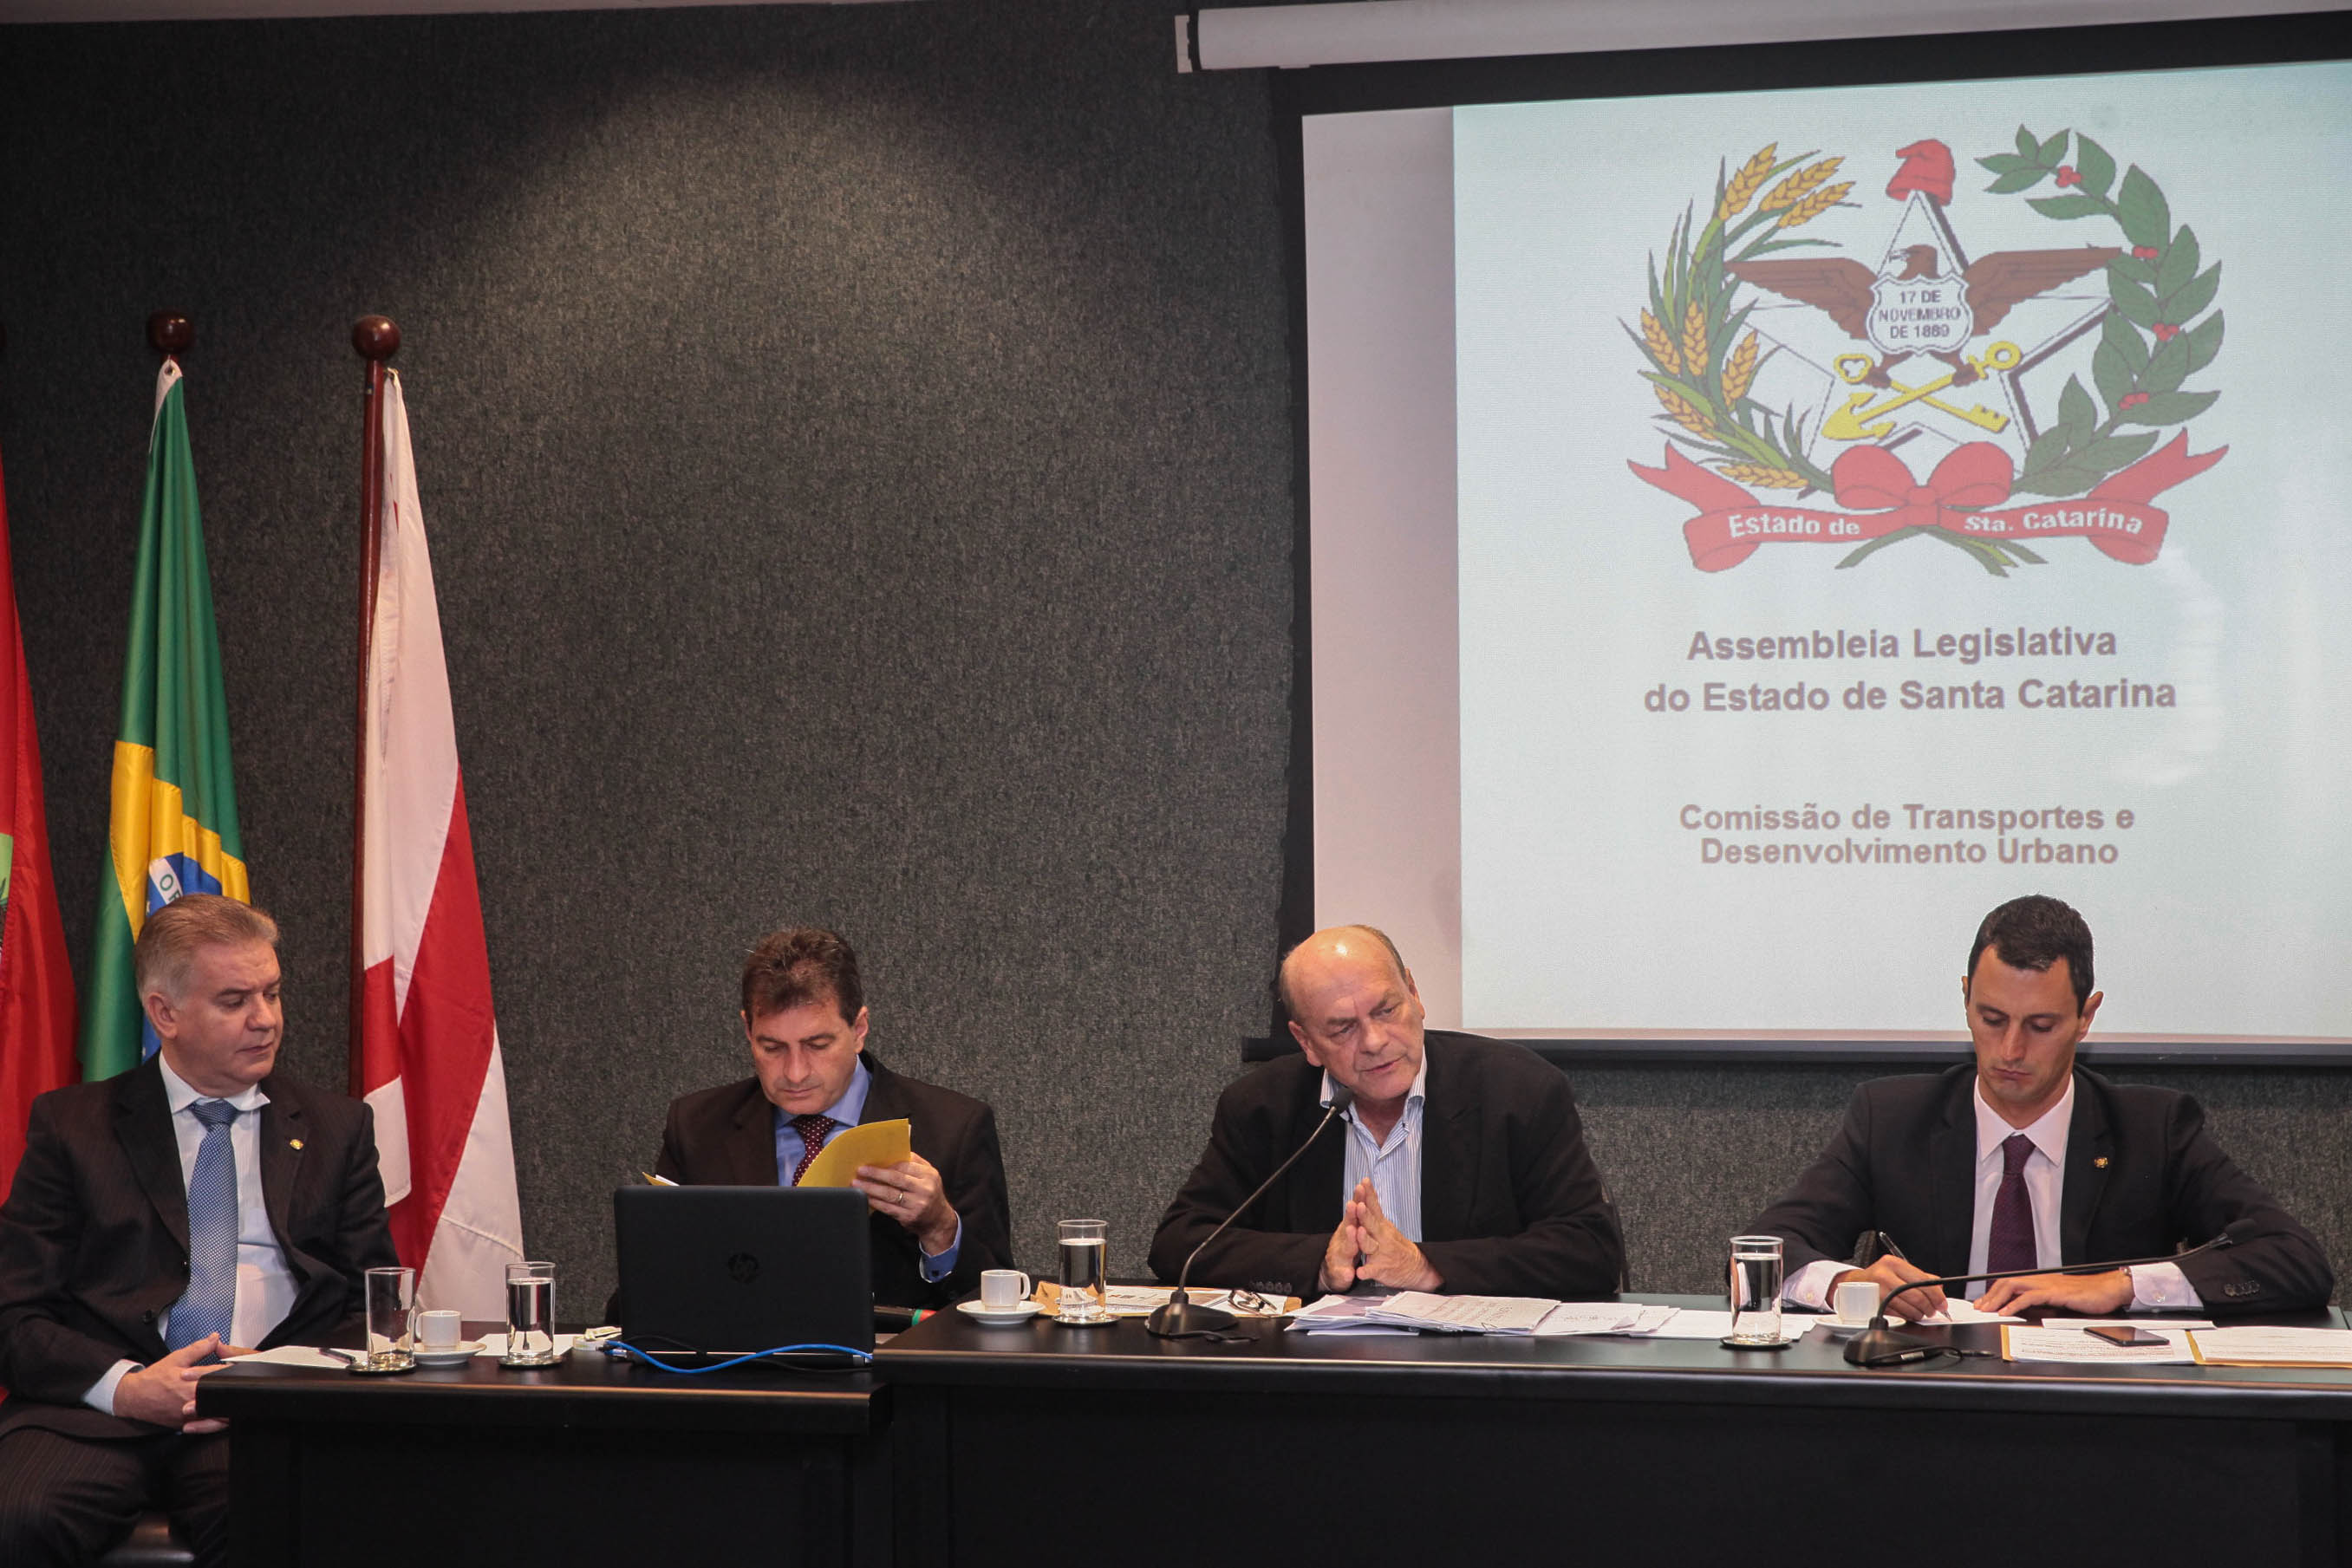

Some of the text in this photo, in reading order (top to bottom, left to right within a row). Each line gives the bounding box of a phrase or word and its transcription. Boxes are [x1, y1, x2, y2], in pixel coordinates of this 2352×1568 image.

[1900, 290, 1942, 304] 17 DE
[1879, 307, 1961, 322] NOVEMBRO
[1890, 325, 1909, 340] DE
[1728, 513, 1861, 539] Estado de
[1963, 506, 2144, 536] Sta. Catarina
[1686, 626, 2118, 666] Assembleia Legislativa
[1644, 677, 2178, 712] do Estado de Santa Catarina
[1678, 802, 2136, 836] Comissão de Transportes e
[1700, 836, 2121, 865] Desenvolvimento Urbano
